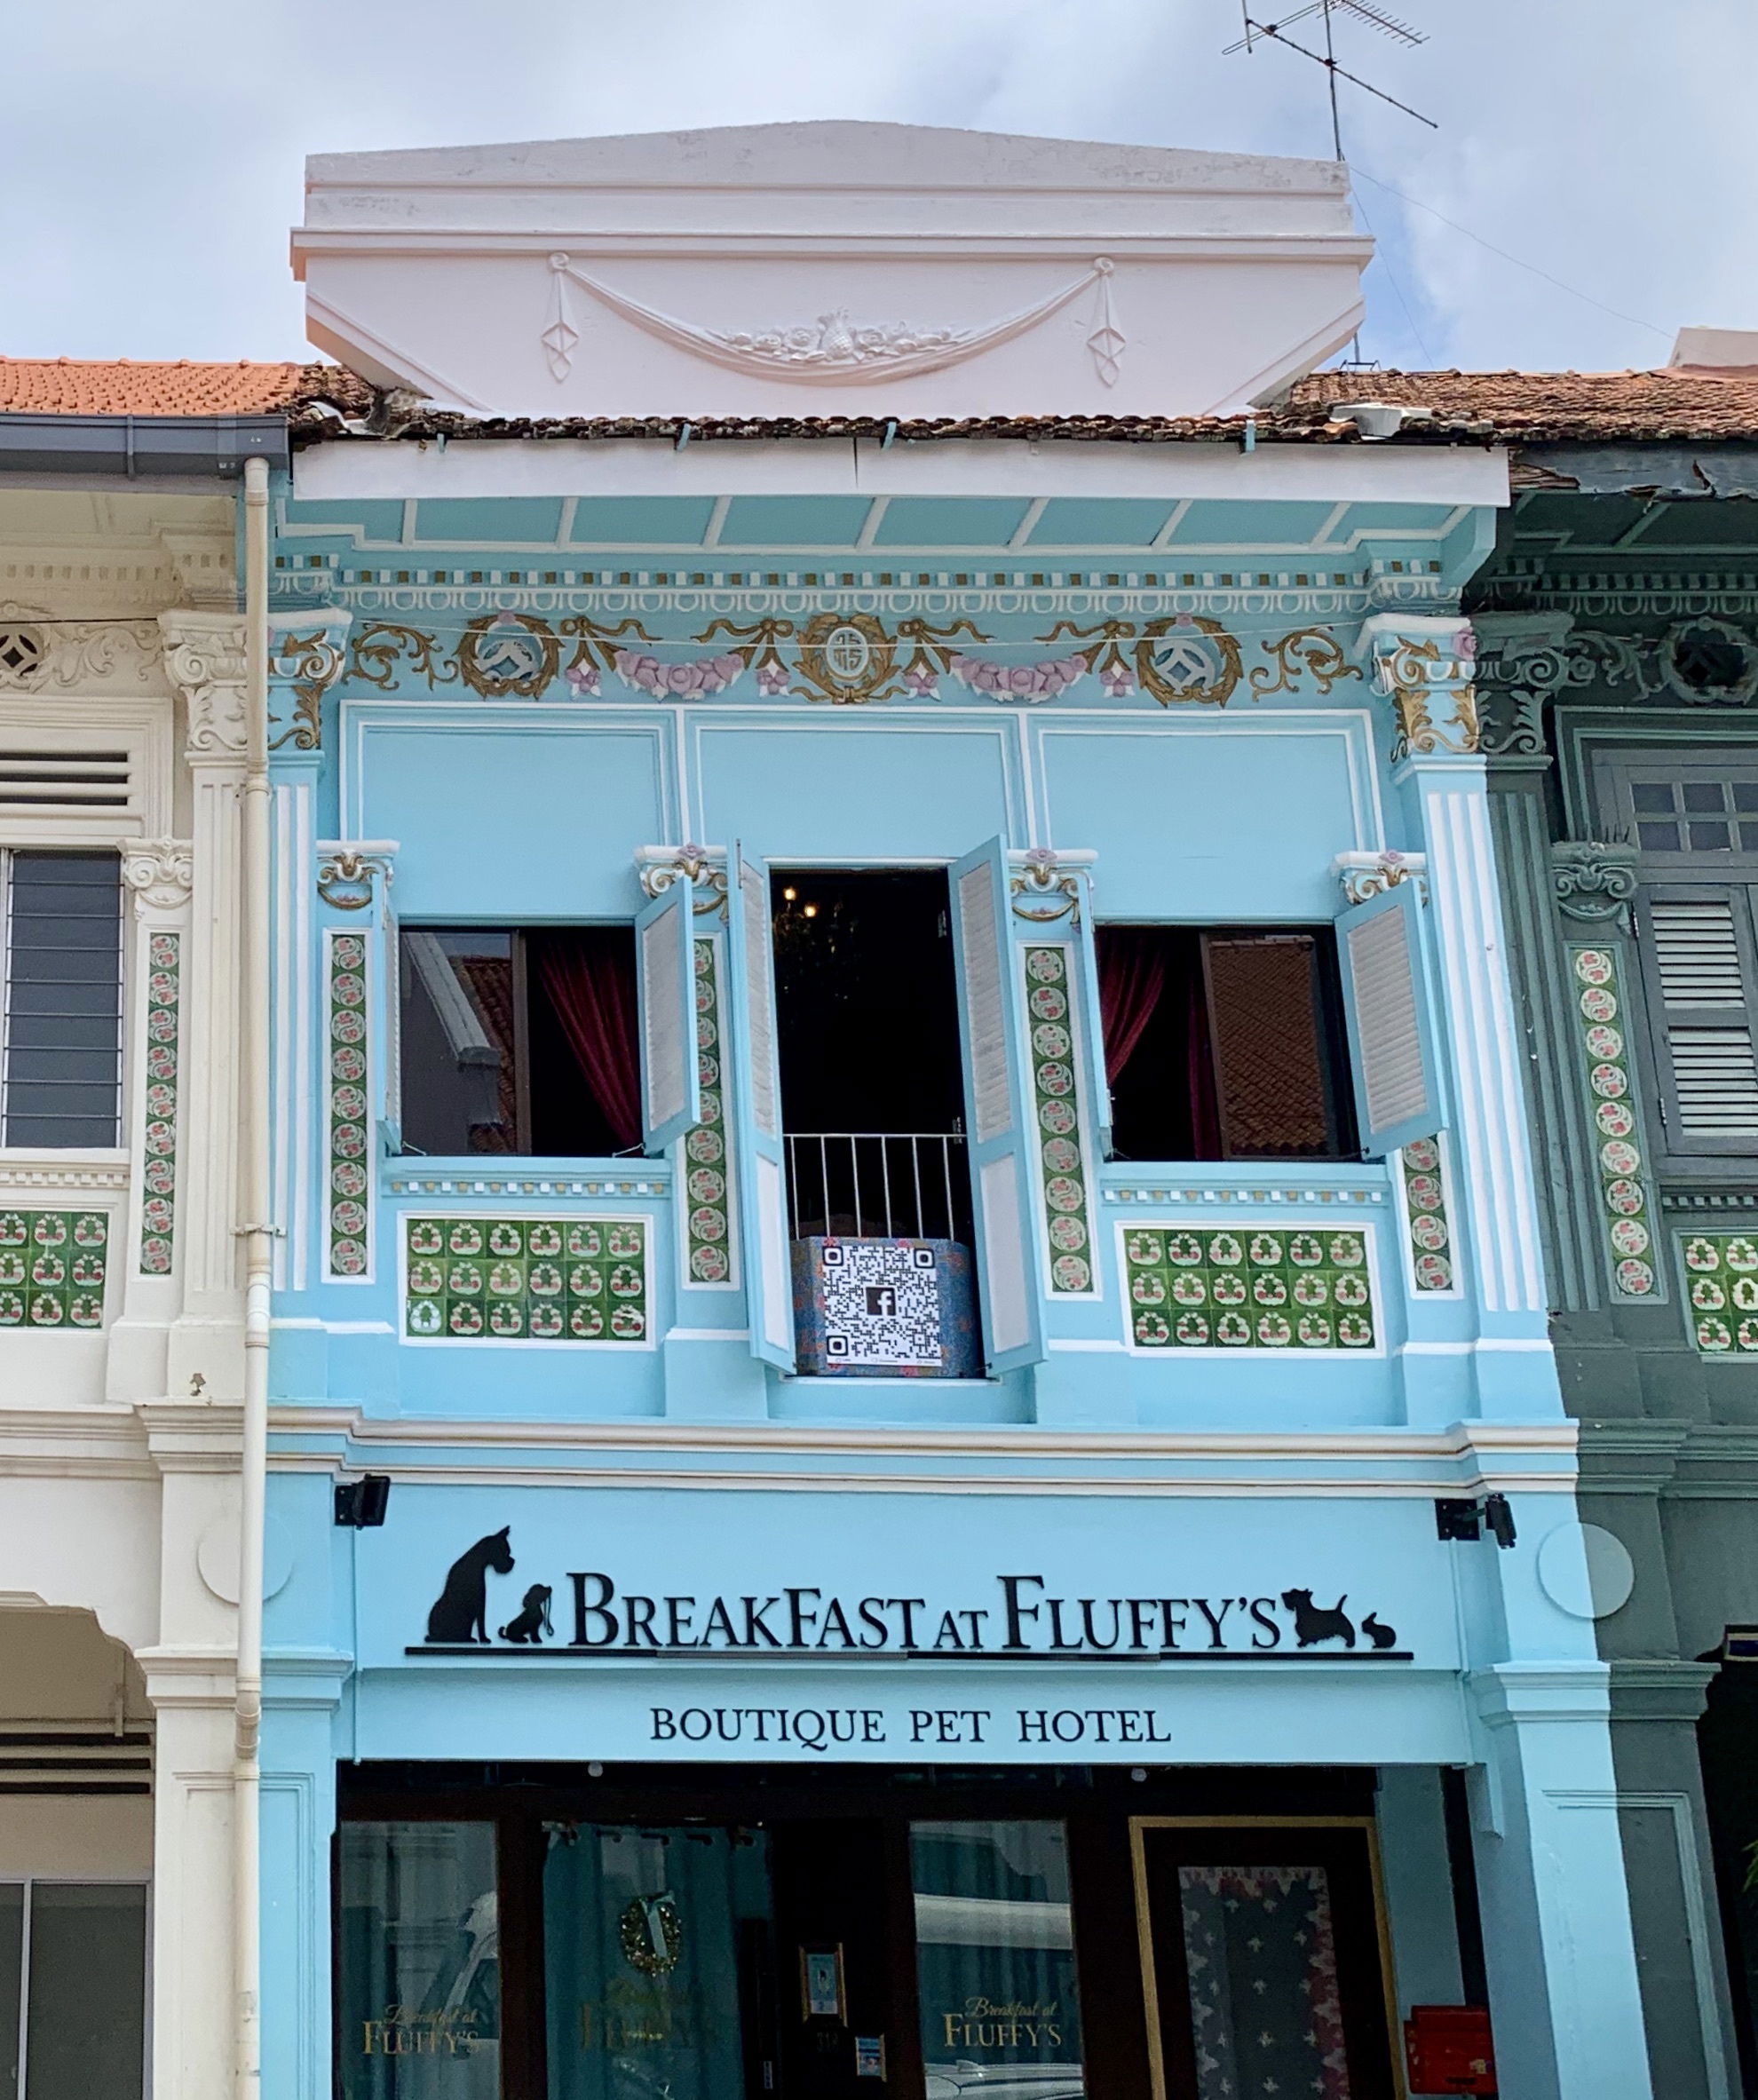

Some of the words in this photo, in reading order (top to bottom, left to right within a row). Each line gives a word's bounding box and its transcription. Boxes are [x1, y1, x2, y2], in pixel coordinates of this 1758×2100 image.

[932, 1610, 989, 1650] AT
[996, 1574, 1280, 1650] FLUFFY'S
[650, 1708, 885, 1751] BOUTIQUE
[908, 1709, 991, 1743] PET
[1017, 1709, 1172, 1743] HOTEL
[965, 1996, 1038, 2021] Breakfast
[1041, 2001, 1058, 2017] at
[942, 2012, 1063, 2048] FLUFFY'S
